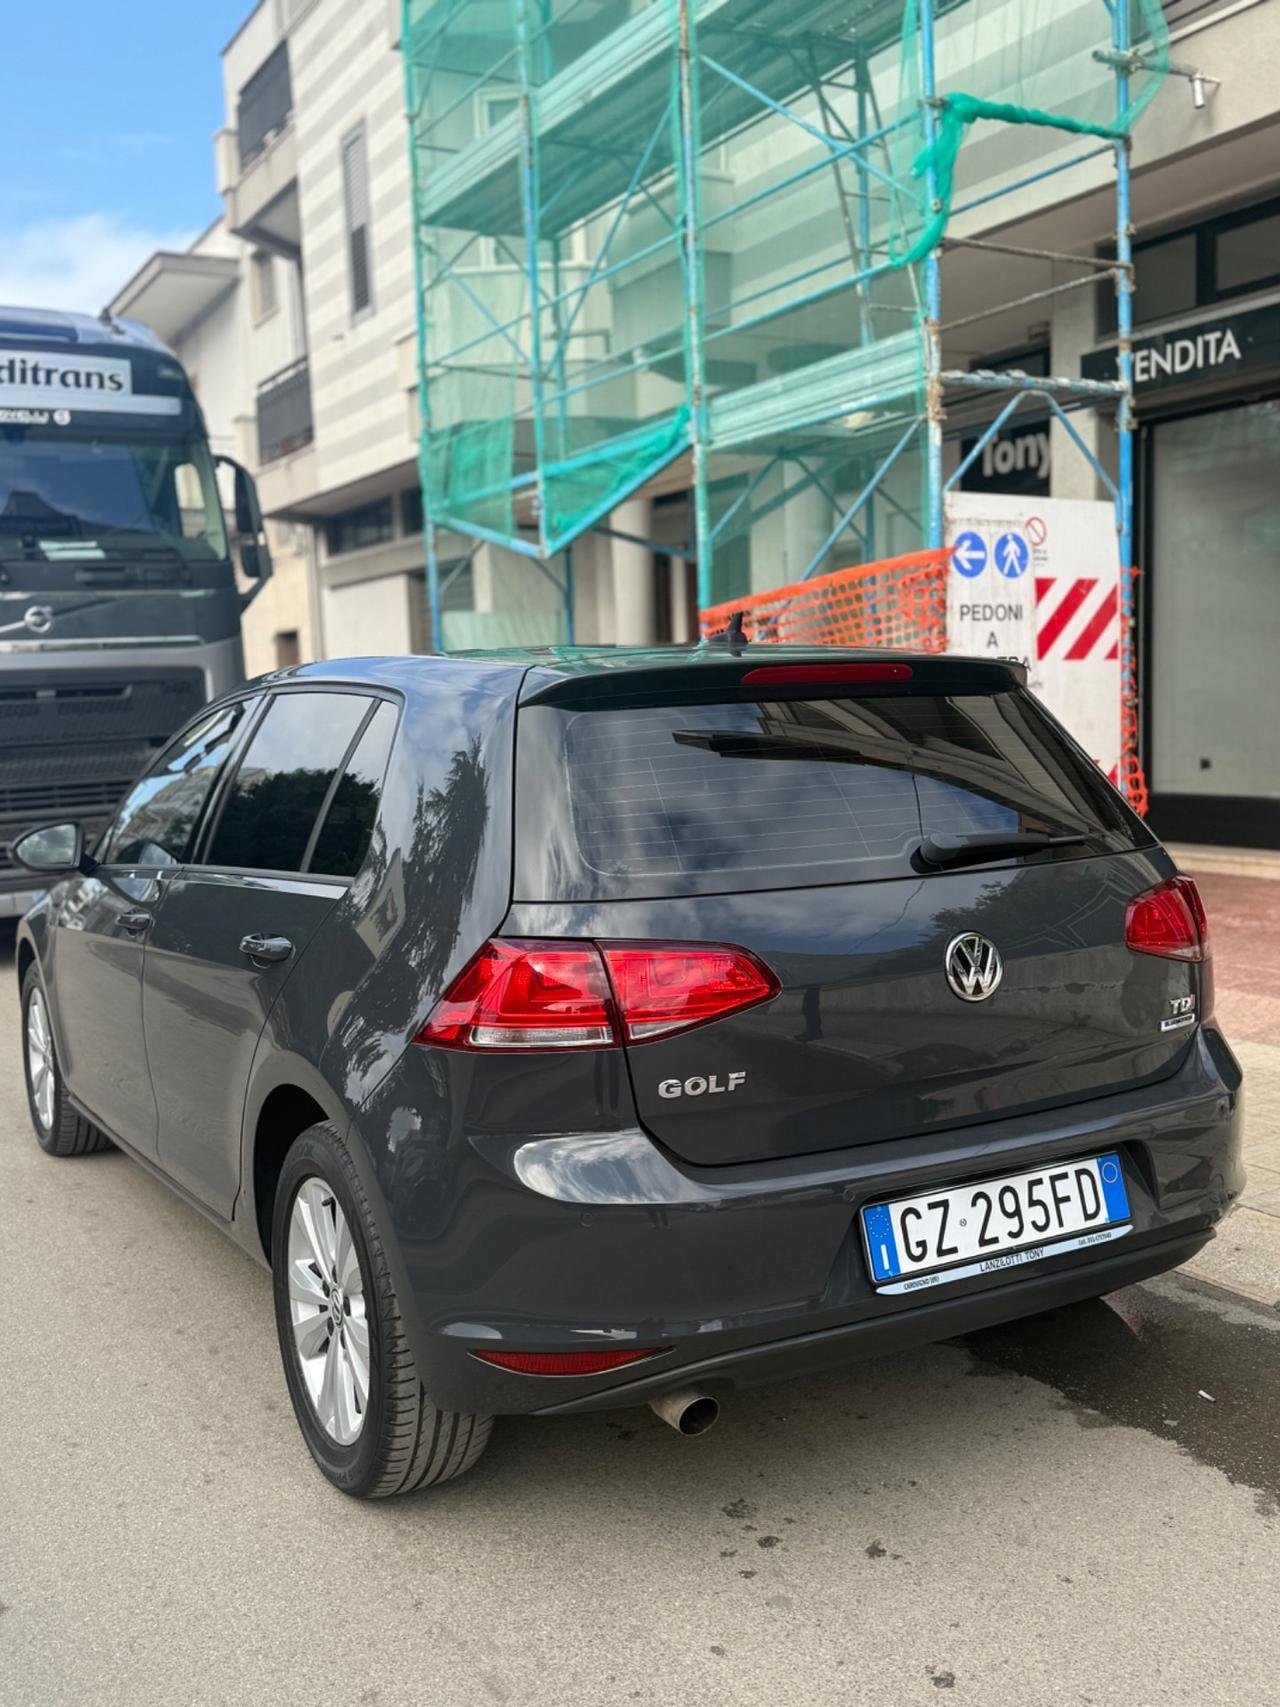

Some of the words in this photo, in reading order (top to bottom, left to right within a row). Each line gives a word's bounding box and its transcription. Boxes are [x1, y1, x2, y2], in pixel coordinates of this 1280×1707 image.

[960, 603, 1023, 621] PEDONI
[986, 631, 999, 648] A
[658, 1071, 746, 1099] GOLF
[900, 1198, 959, 1263] GZ
[970, 1168, 1101, 1248] 295FD
[1025, 1247, 1044, 1260] TONY
